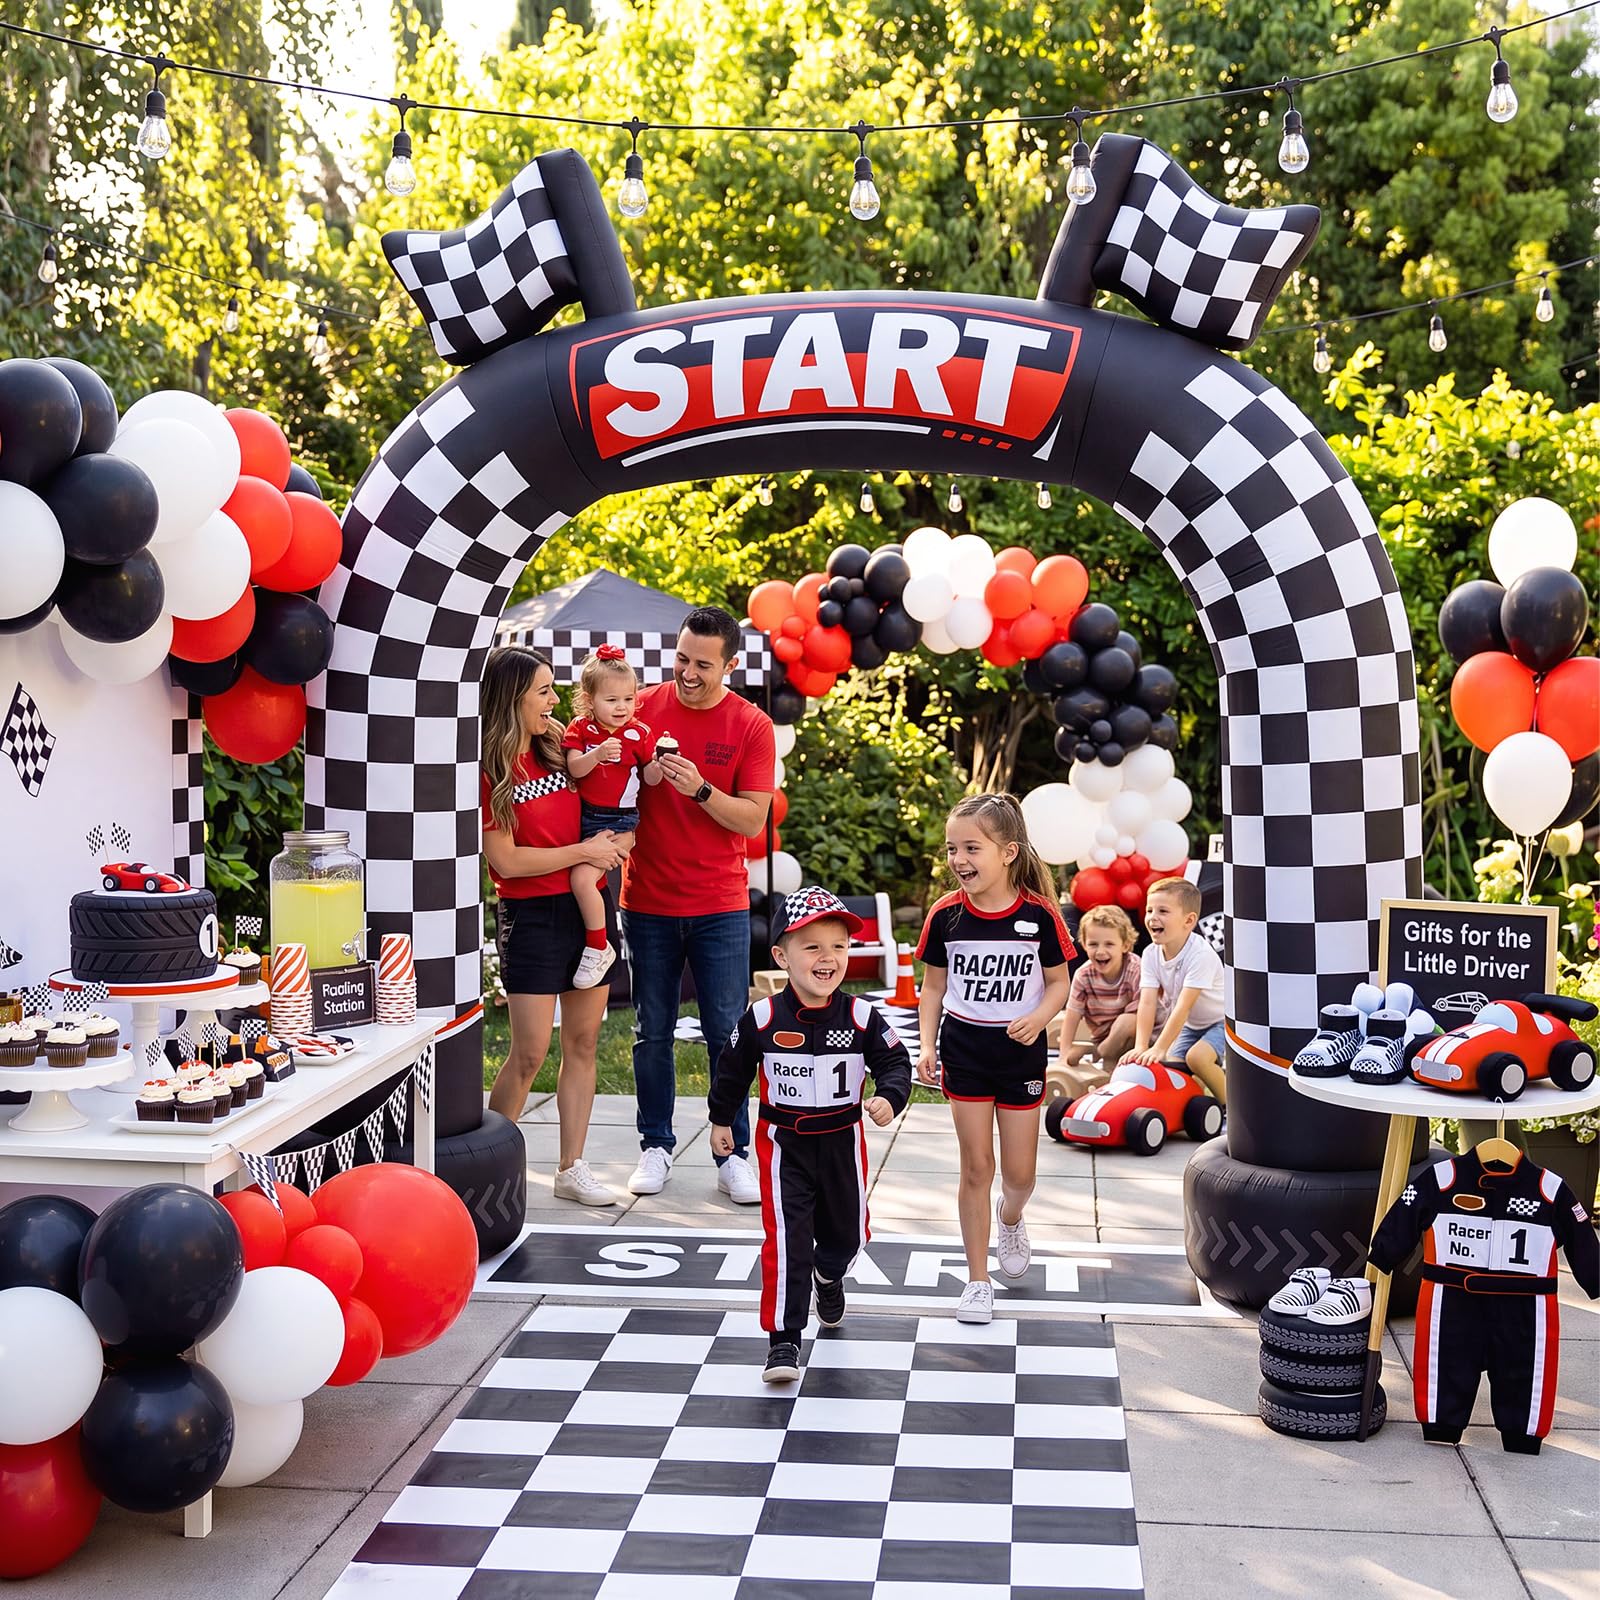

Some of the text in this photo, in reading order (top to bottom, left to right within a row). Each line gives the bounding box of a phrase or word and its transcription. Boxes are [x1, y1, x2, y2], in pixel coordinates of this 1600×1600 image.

[604, 311, 1052, 438] START
[206, 921, 214, 953] 1
[1404, 921, 1531, 949] Gifts for the
[953, 954, 1034, 977] RACING
[1404, 951, 1530, 980] Little Driver
[963, 979, 1026, 1002] TEAM
[324, 999, 365, 1015] Station
[773, 1062, 814, 1078] Racer
[832, 1060, 851, 1099] 1
[778, 1082, 802, 1097] No.
[1448, 1222, 1491, 1240] Racer
[1450, 1241, 1475, 1258] No.
[1508, 1228, 1529, 1266] 1
